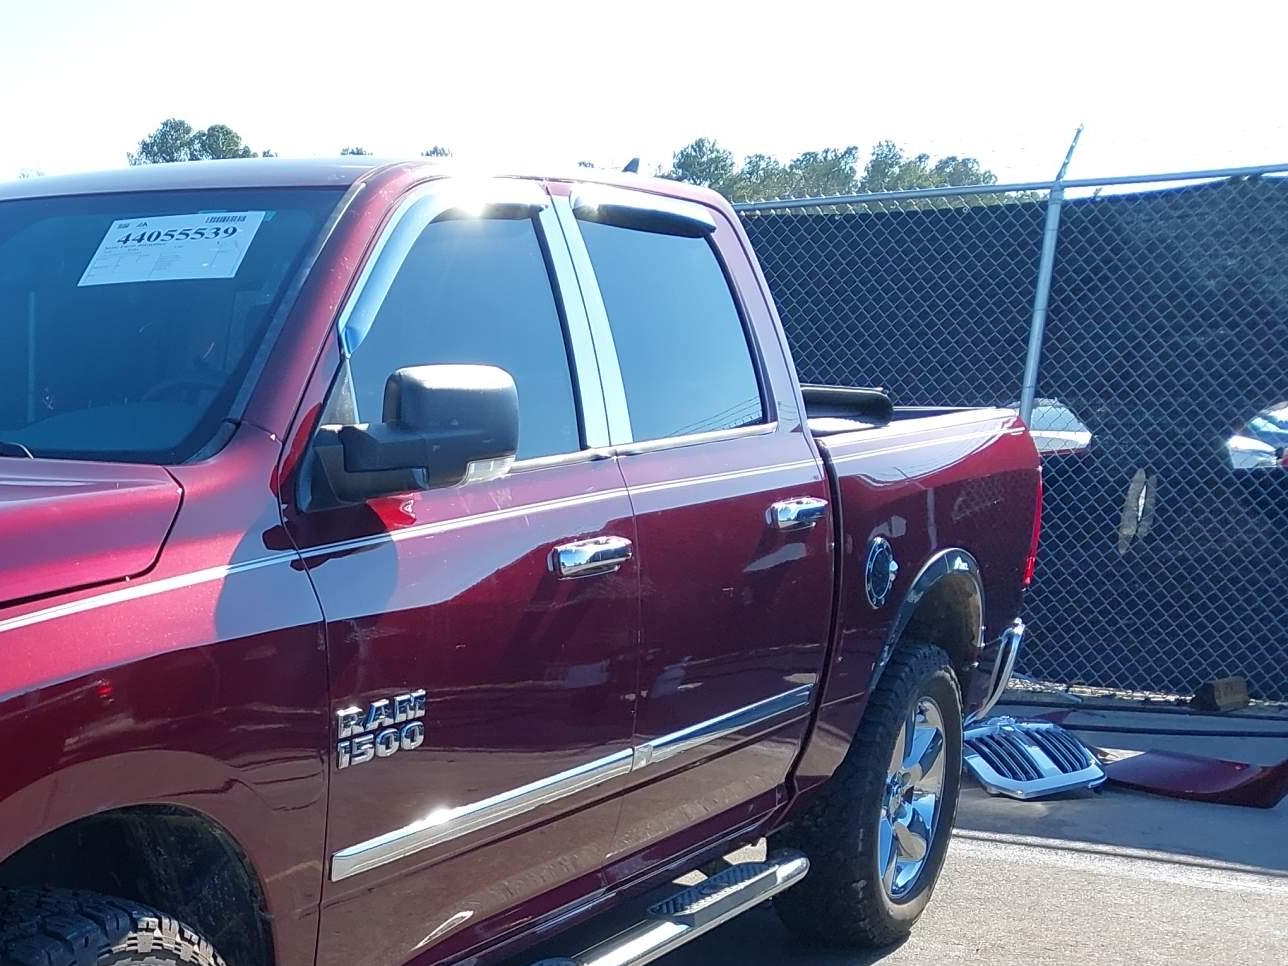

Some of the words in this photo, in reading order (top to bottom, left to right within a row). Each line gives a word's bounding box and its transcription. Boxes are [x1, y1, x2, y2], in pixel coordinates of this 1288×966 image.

[116, 226, 238, 245] 44055539
[336, 689, 427, 739] RAM
[337, 721, 425, 769] 1500
